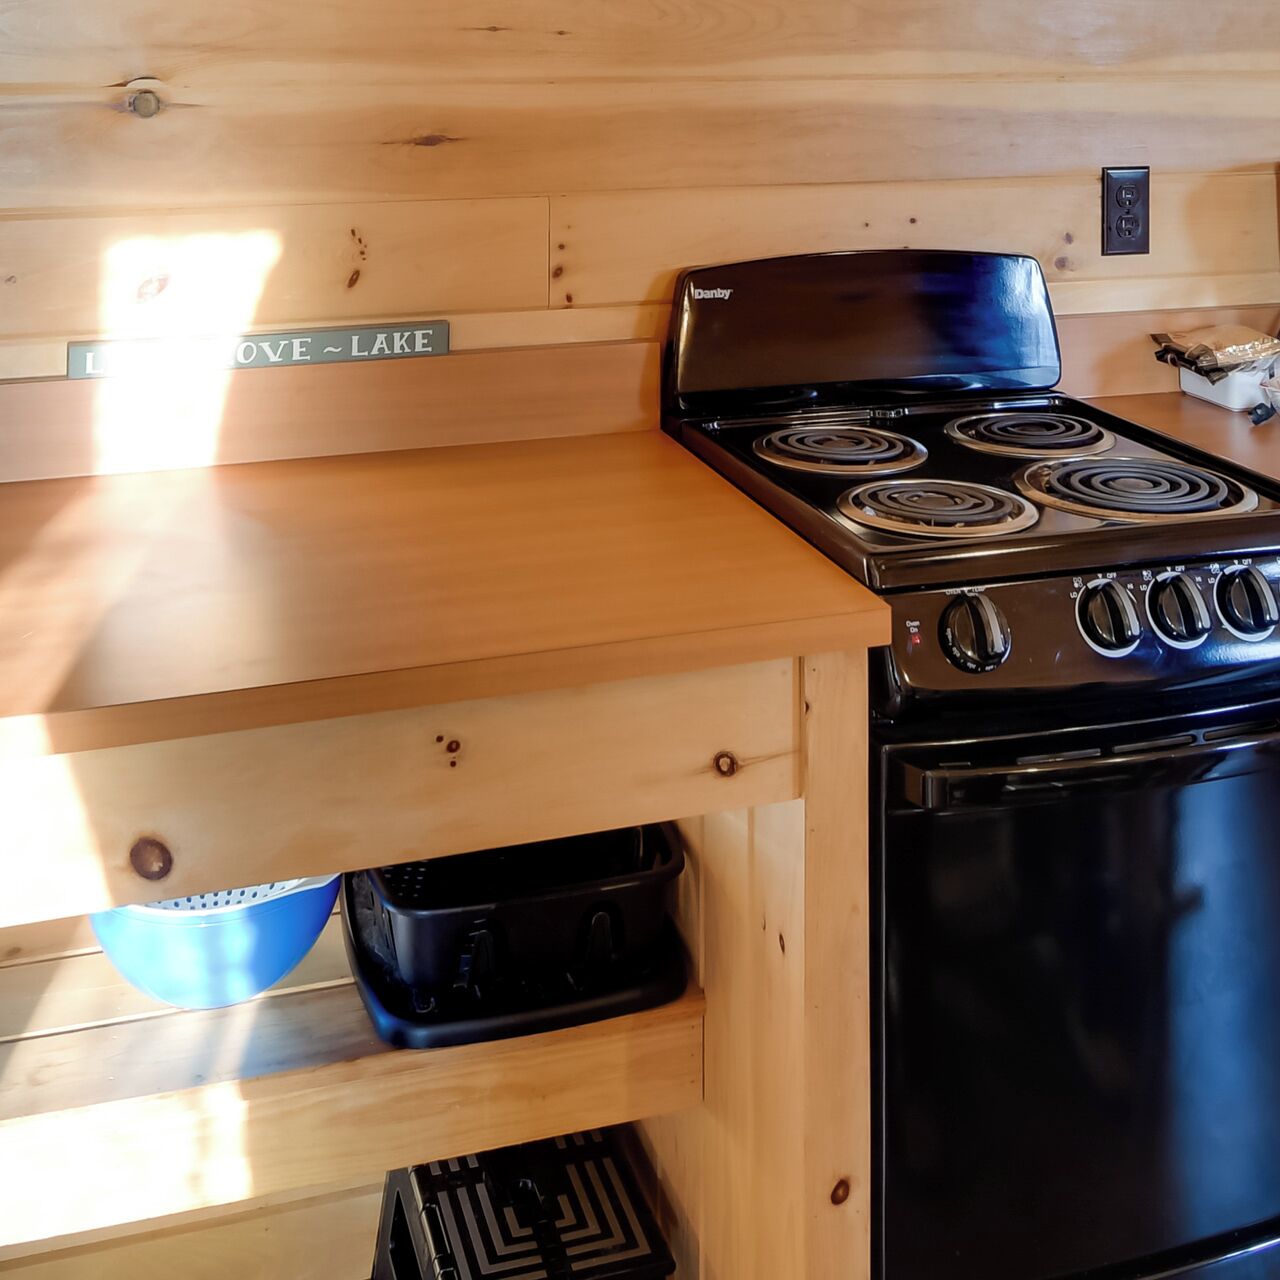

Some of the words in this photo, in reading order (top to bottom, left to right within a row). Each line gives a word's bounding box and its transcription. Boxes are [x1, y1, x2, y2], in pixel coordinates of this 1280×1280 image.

[695, 287, 731, 300] Danby
[231, 337, 312, 365] OVE
[351, 329, 434, 357] LAKE
